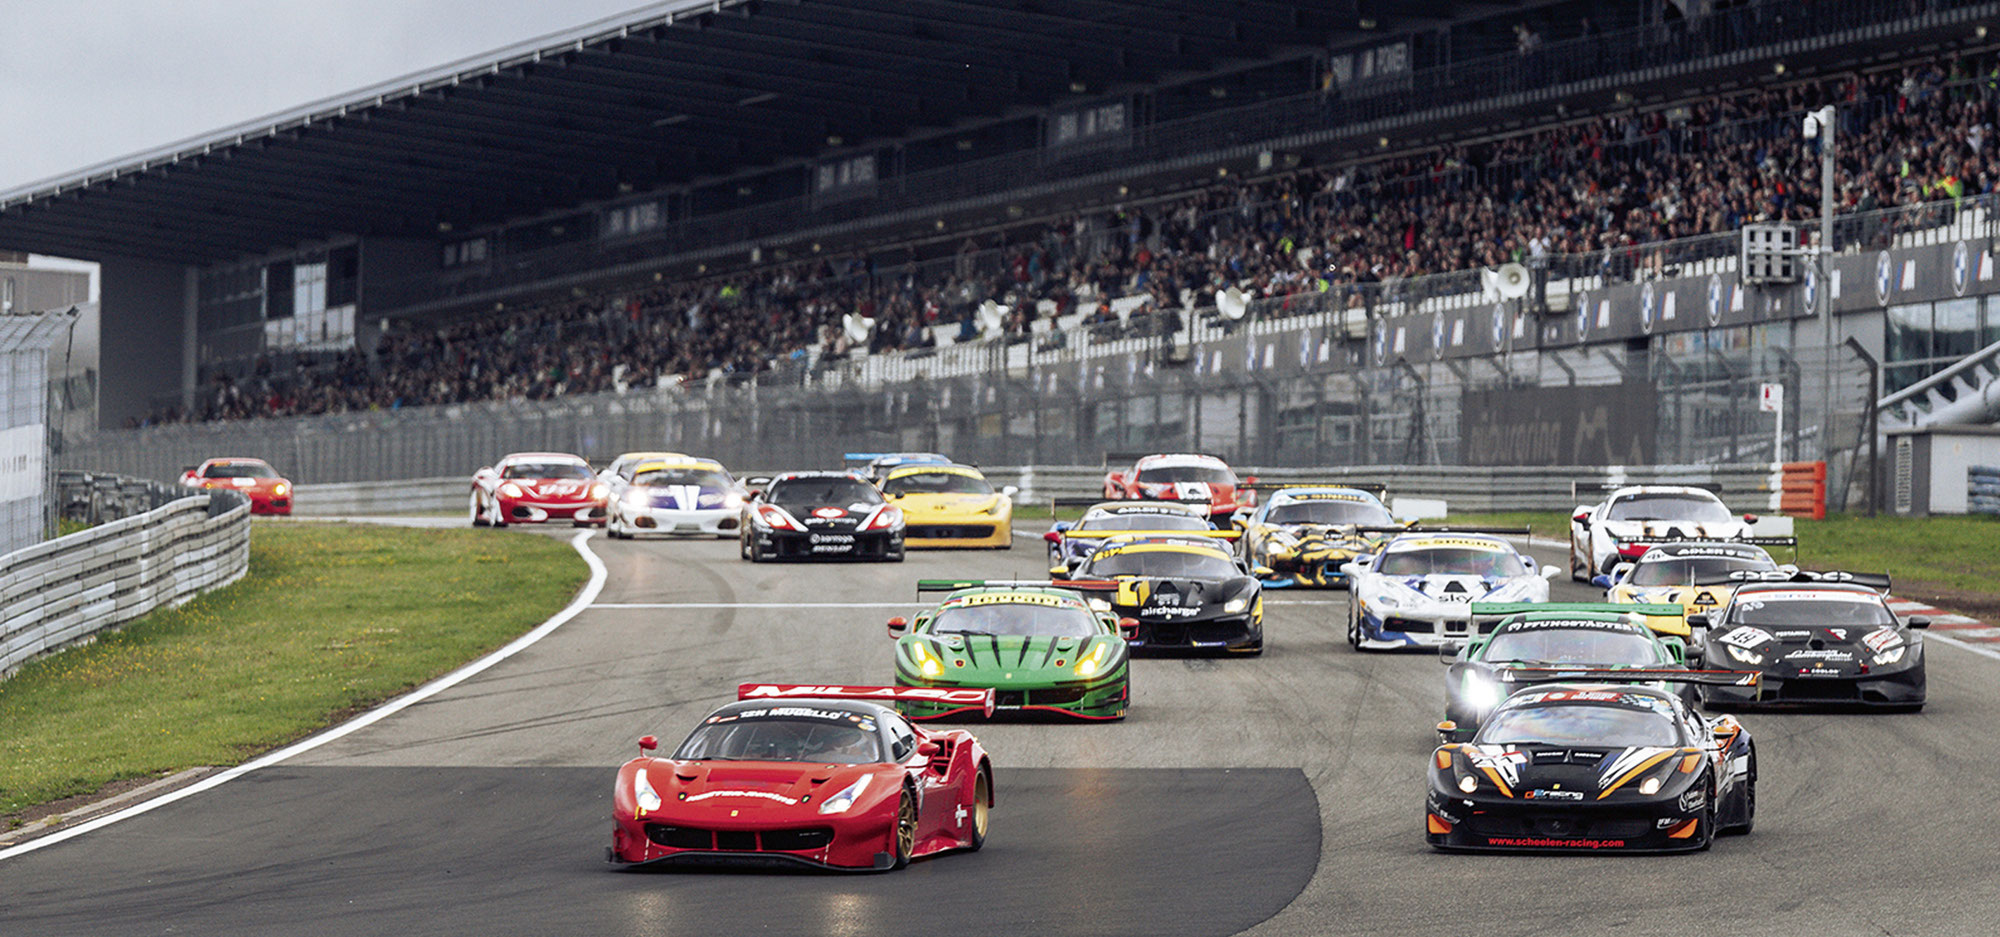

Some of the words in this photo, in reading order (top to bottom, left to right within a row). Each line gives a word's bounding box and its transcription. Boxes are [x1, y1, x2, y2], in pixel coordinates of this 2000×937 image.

[1677, 549, 1724, 557] ADLER
[1438, 593, 1474, 604] sky
[768, 706, 841, 720] MUGELLO
[1487, 837, 1625, 849] www.scheelen-racing.com
